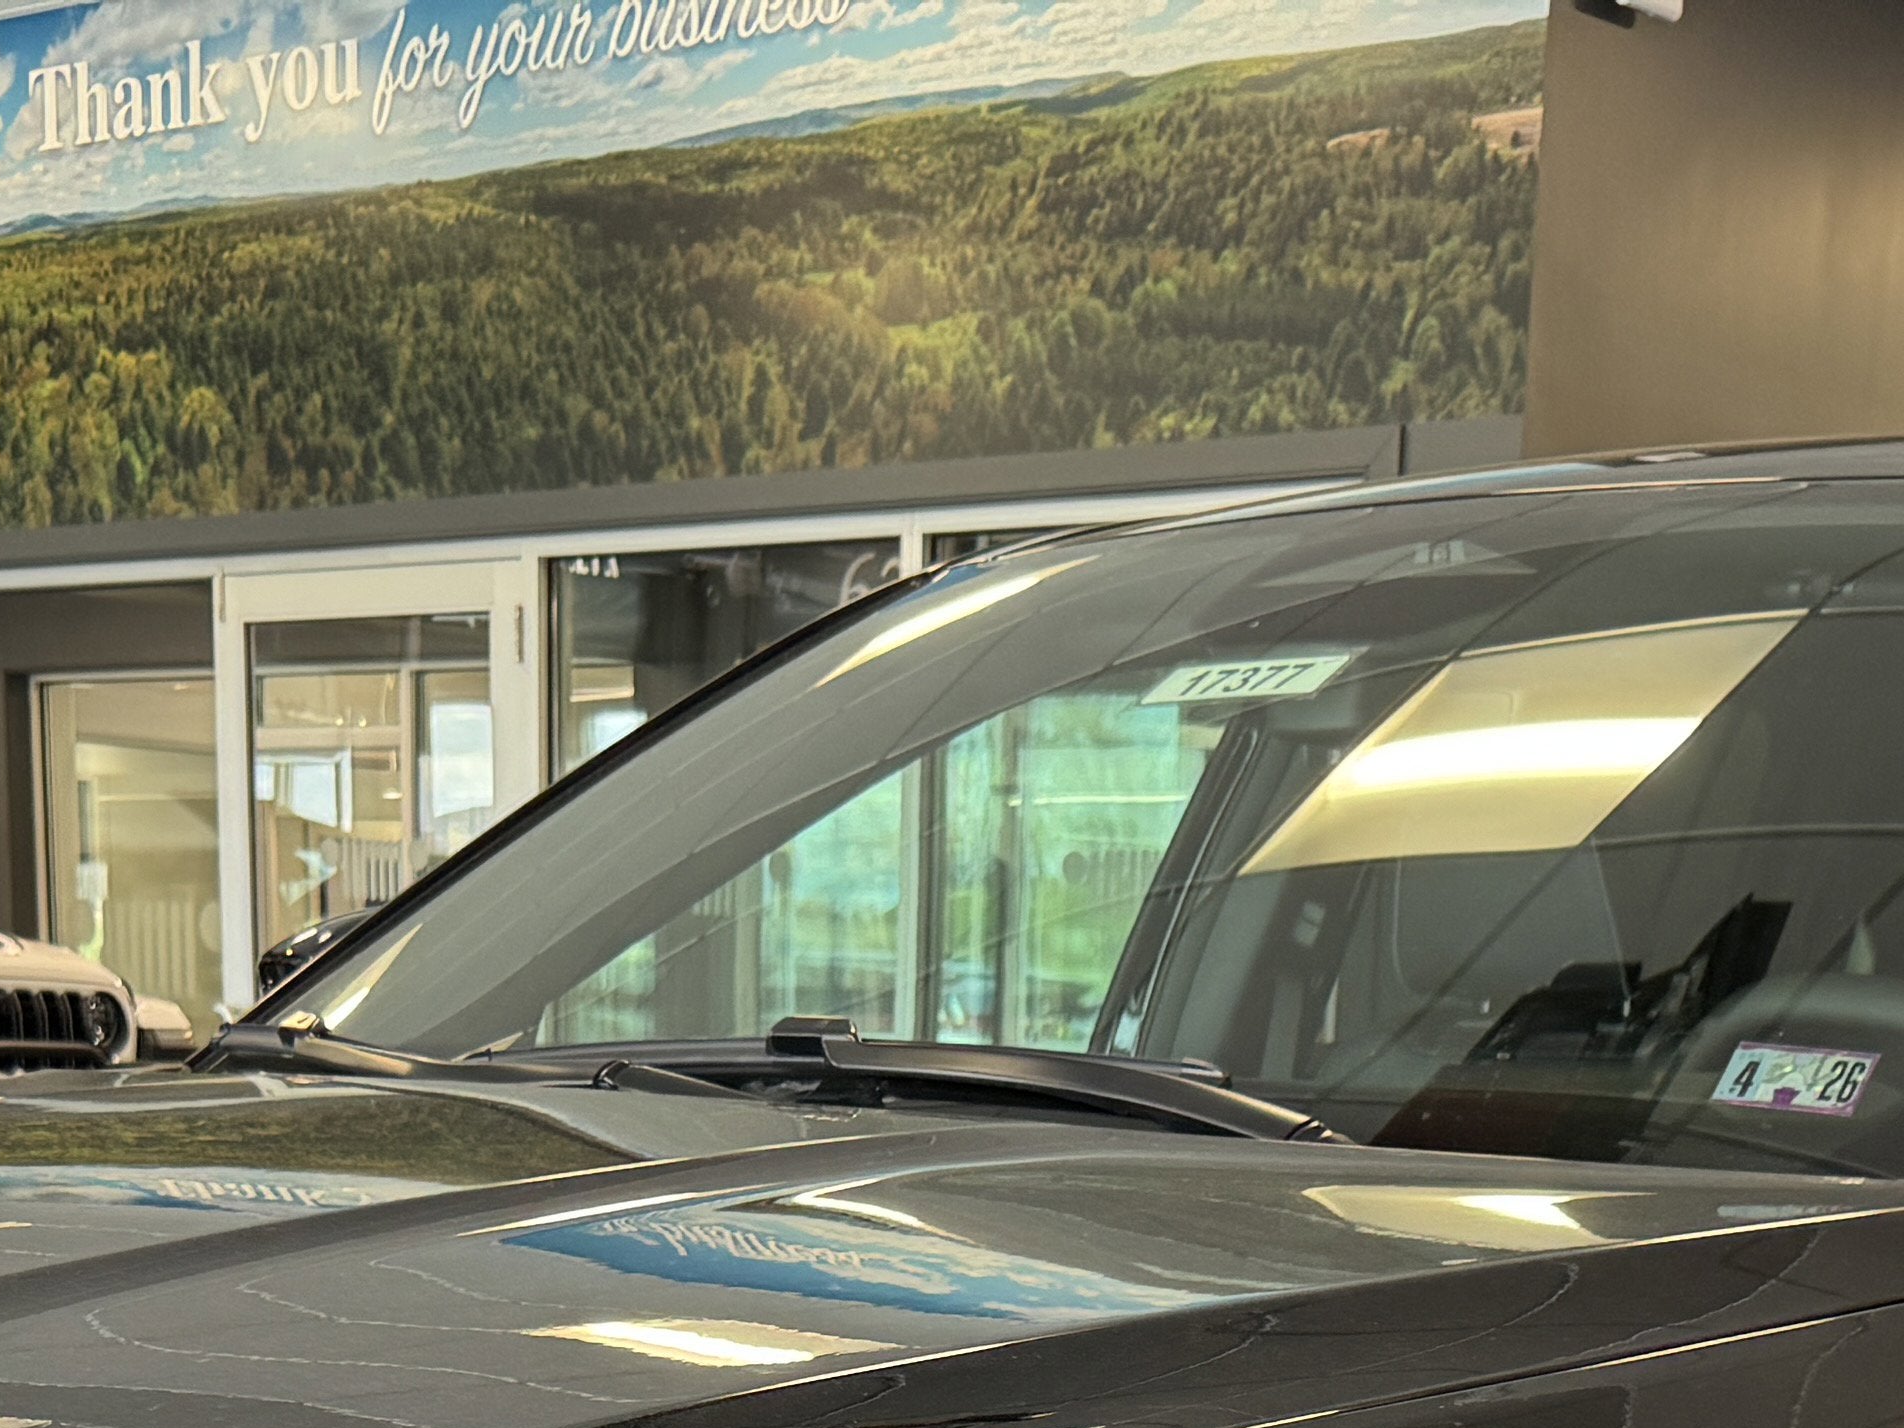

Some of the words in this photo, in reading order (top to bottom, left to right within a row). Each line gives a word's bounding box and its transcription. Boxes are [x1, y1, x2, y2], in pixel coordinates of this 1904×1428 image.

[27, 39, 229, 153] Thank
[244, 37, 363, 143] you
[371, 6, 453, 135] for
[459, 8, 595, 129] your
[607, 0, 850, 59] business
[1179, 662, 1316, 697] 17377
[1732, 1060, 1761, 1098] 4
[1816, 1060, 1867, 1103] 26
